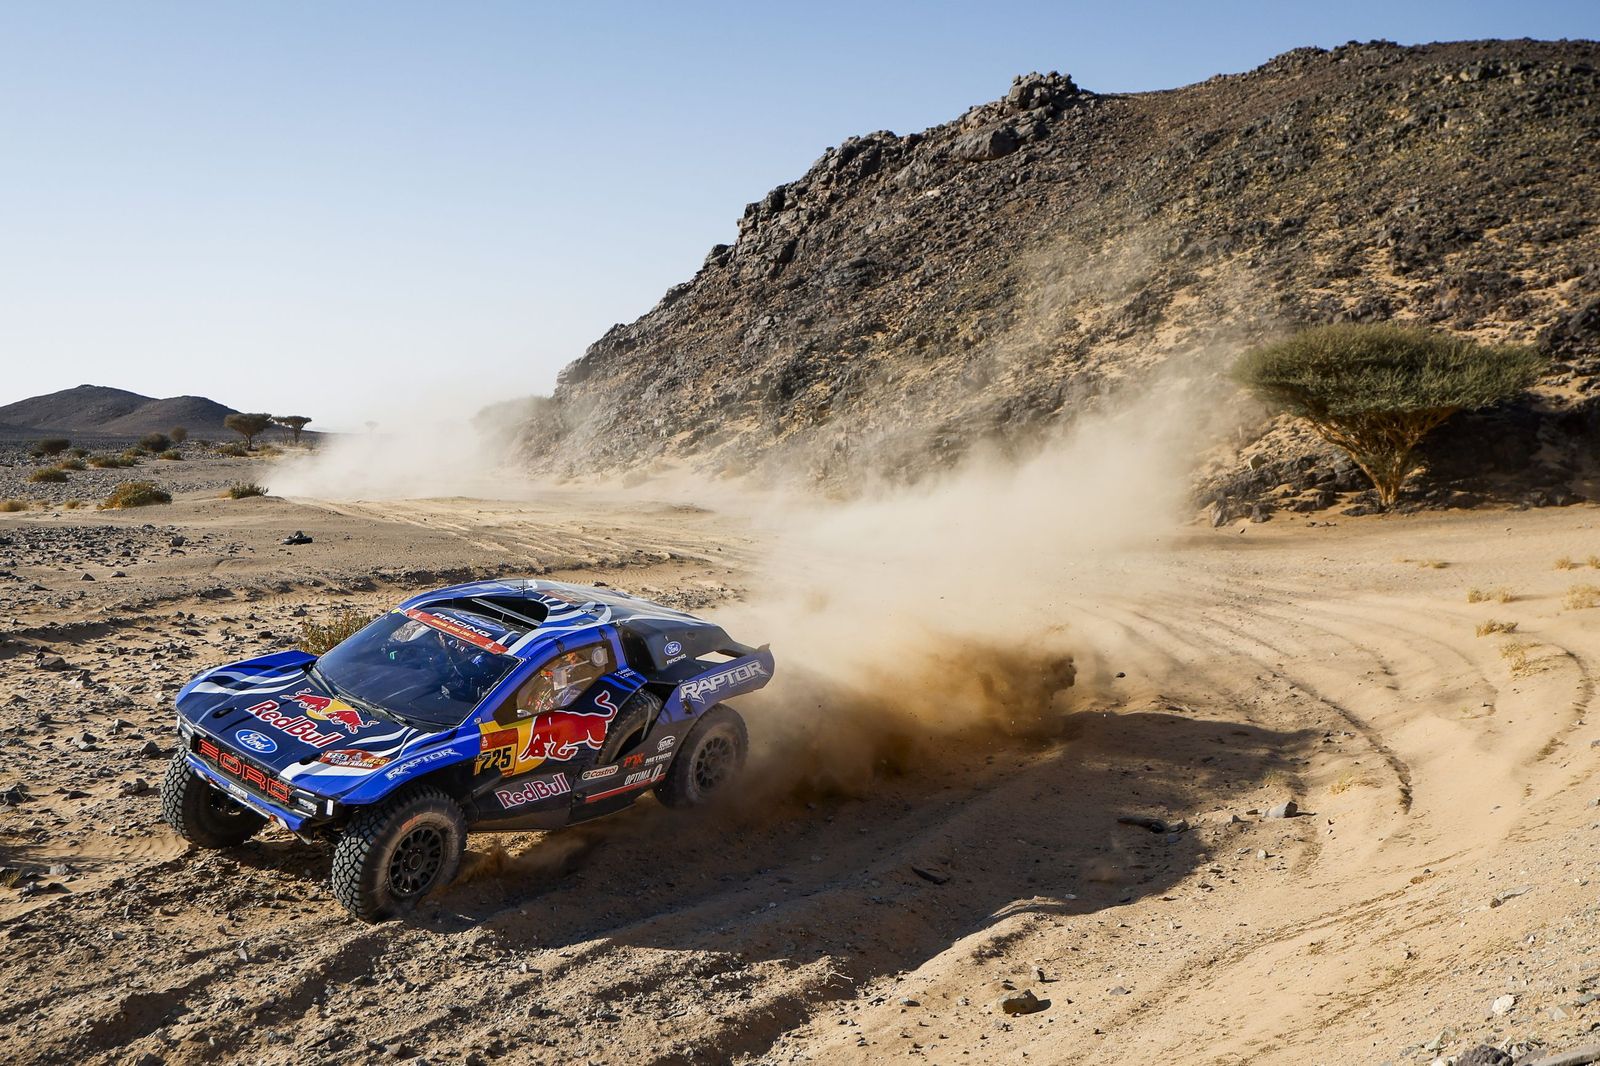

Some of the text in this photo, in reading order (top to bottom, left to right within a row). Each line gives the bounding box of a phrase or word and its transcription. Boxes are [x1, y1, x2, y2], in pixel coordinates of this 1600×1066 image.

[666, 653, 687, 665] RACING
[679, 659, 770, 704] RAPTOR
[240, 732, 271, 750] Ford
[384, 747, 464, 781] RAPTOR
[644, 751, 673, 764] METHOD
[199, 738, 292, 805] FORD
[591, 766, 617, 778] Castrol
[623, 768, 652, 786] OPTIMA
